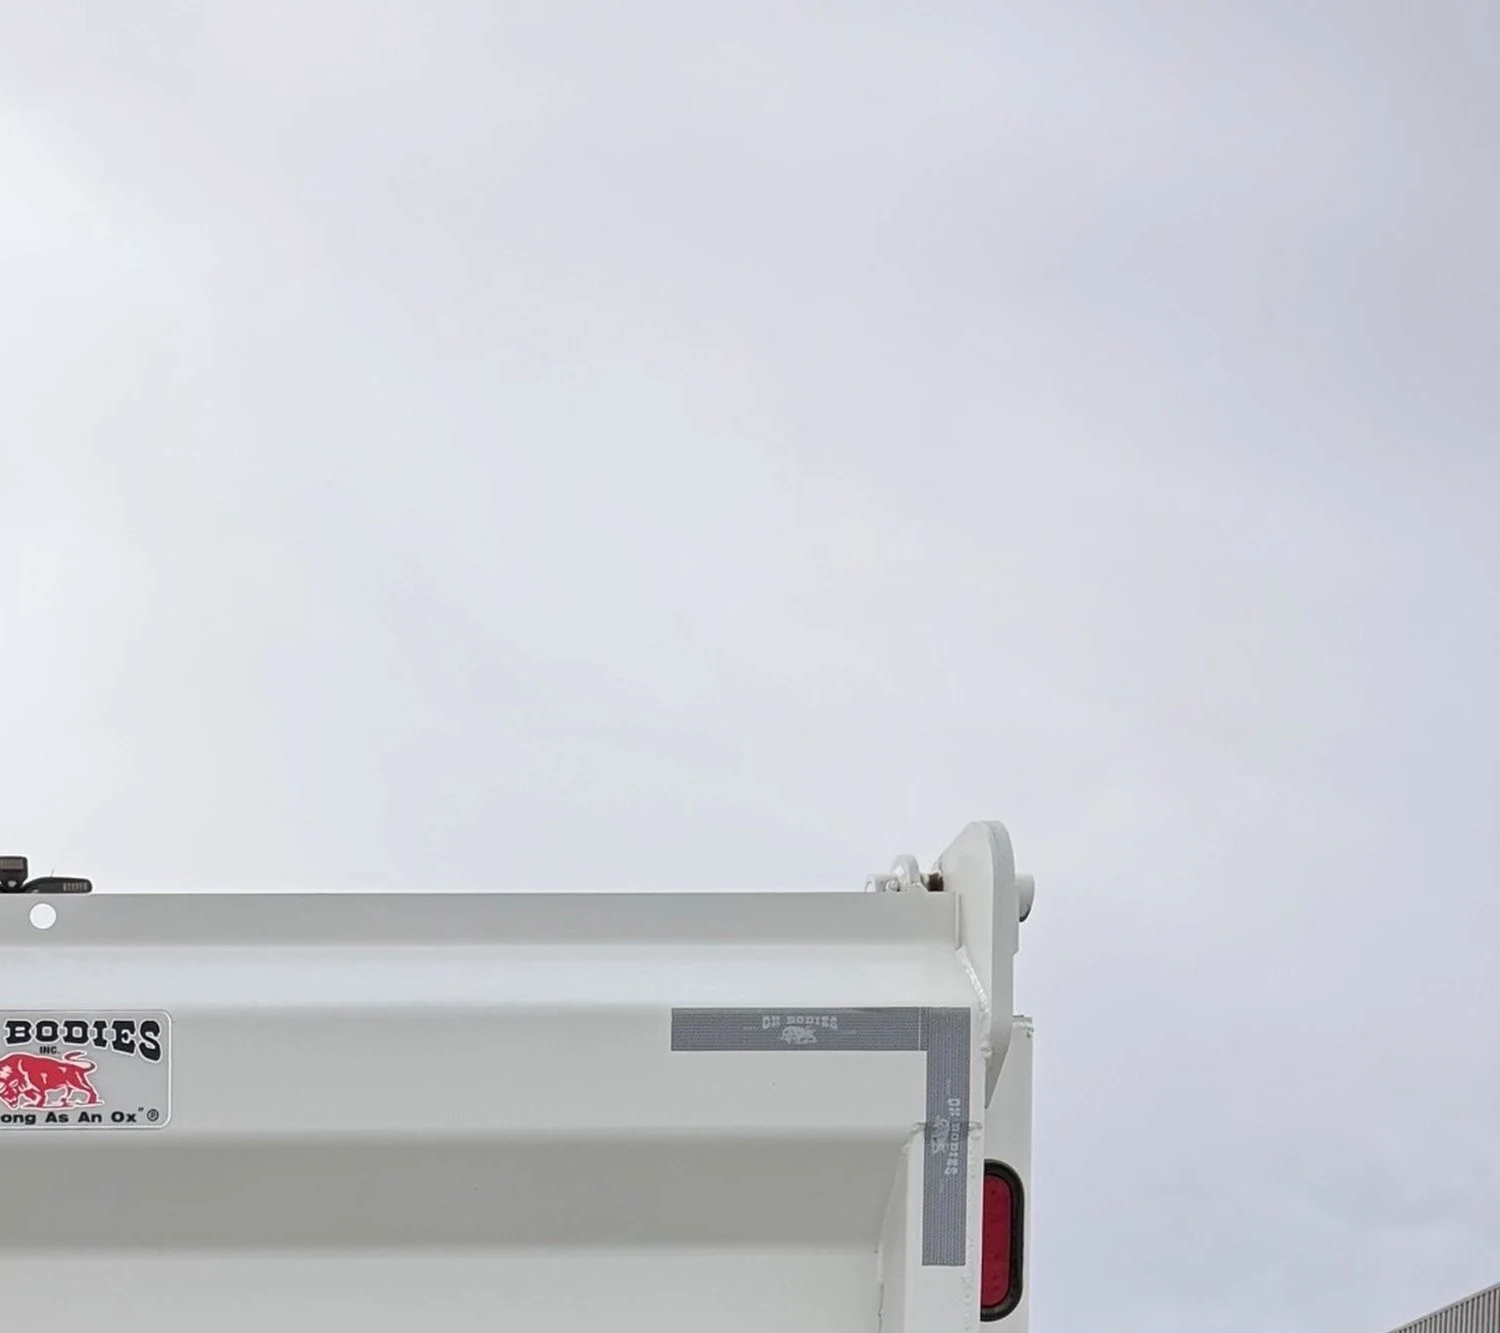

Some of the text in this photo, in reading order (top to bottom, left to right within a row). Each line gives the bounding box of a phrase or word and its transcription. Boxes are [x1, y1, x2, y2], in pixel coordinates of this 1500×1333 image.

[4, 1019, 161, 1062] BODIES
[45, 1111, 69, 1123] As
[77, 1111, 102, 1123] An
